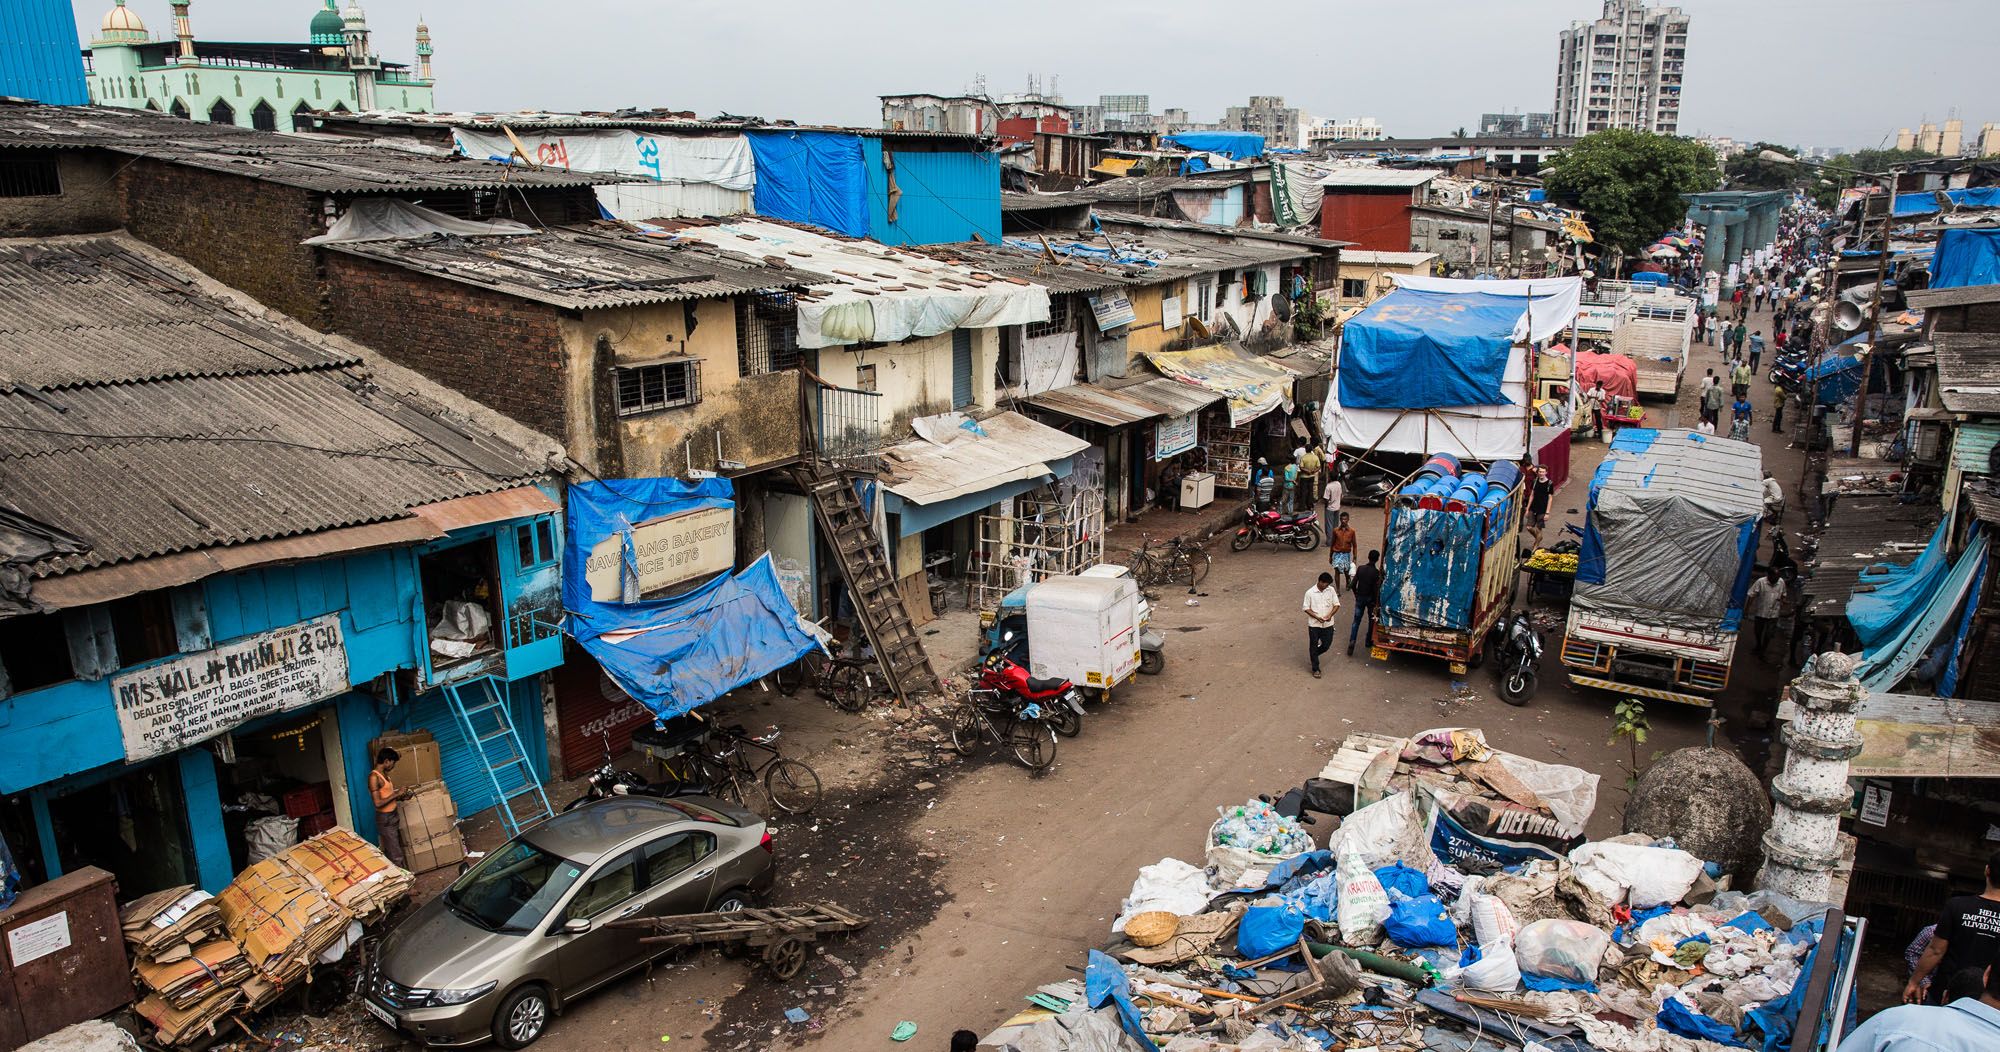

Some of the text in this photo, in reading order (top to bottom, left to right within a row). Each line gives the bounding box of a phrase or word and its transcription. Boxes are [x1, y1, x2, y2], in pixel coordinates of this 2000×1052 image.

[586, 521, 730, 573] NAVAANG BAKERY
[618, 547, 699, 583] NCE 1976
[297, 632, 314, 656] &
[133, 701, 176, 721] DEALERS
[192, 685, 225, 704] EMPTY
[143, 727, 166, 741] PLOT
[243, 690, 277, 709] RAILWAY
[151, 714, 172, 728] AND
[174, 700, 208, 720] CARPET
[213, 686, 258, 704] FLOORING
[260, 674, 290, 692] SHEETS
[1474, 845, 1498, 858] OCT
[1962, 913, 1988, 923] EMPTY
[1979, 908, 1998, 919] HELL
